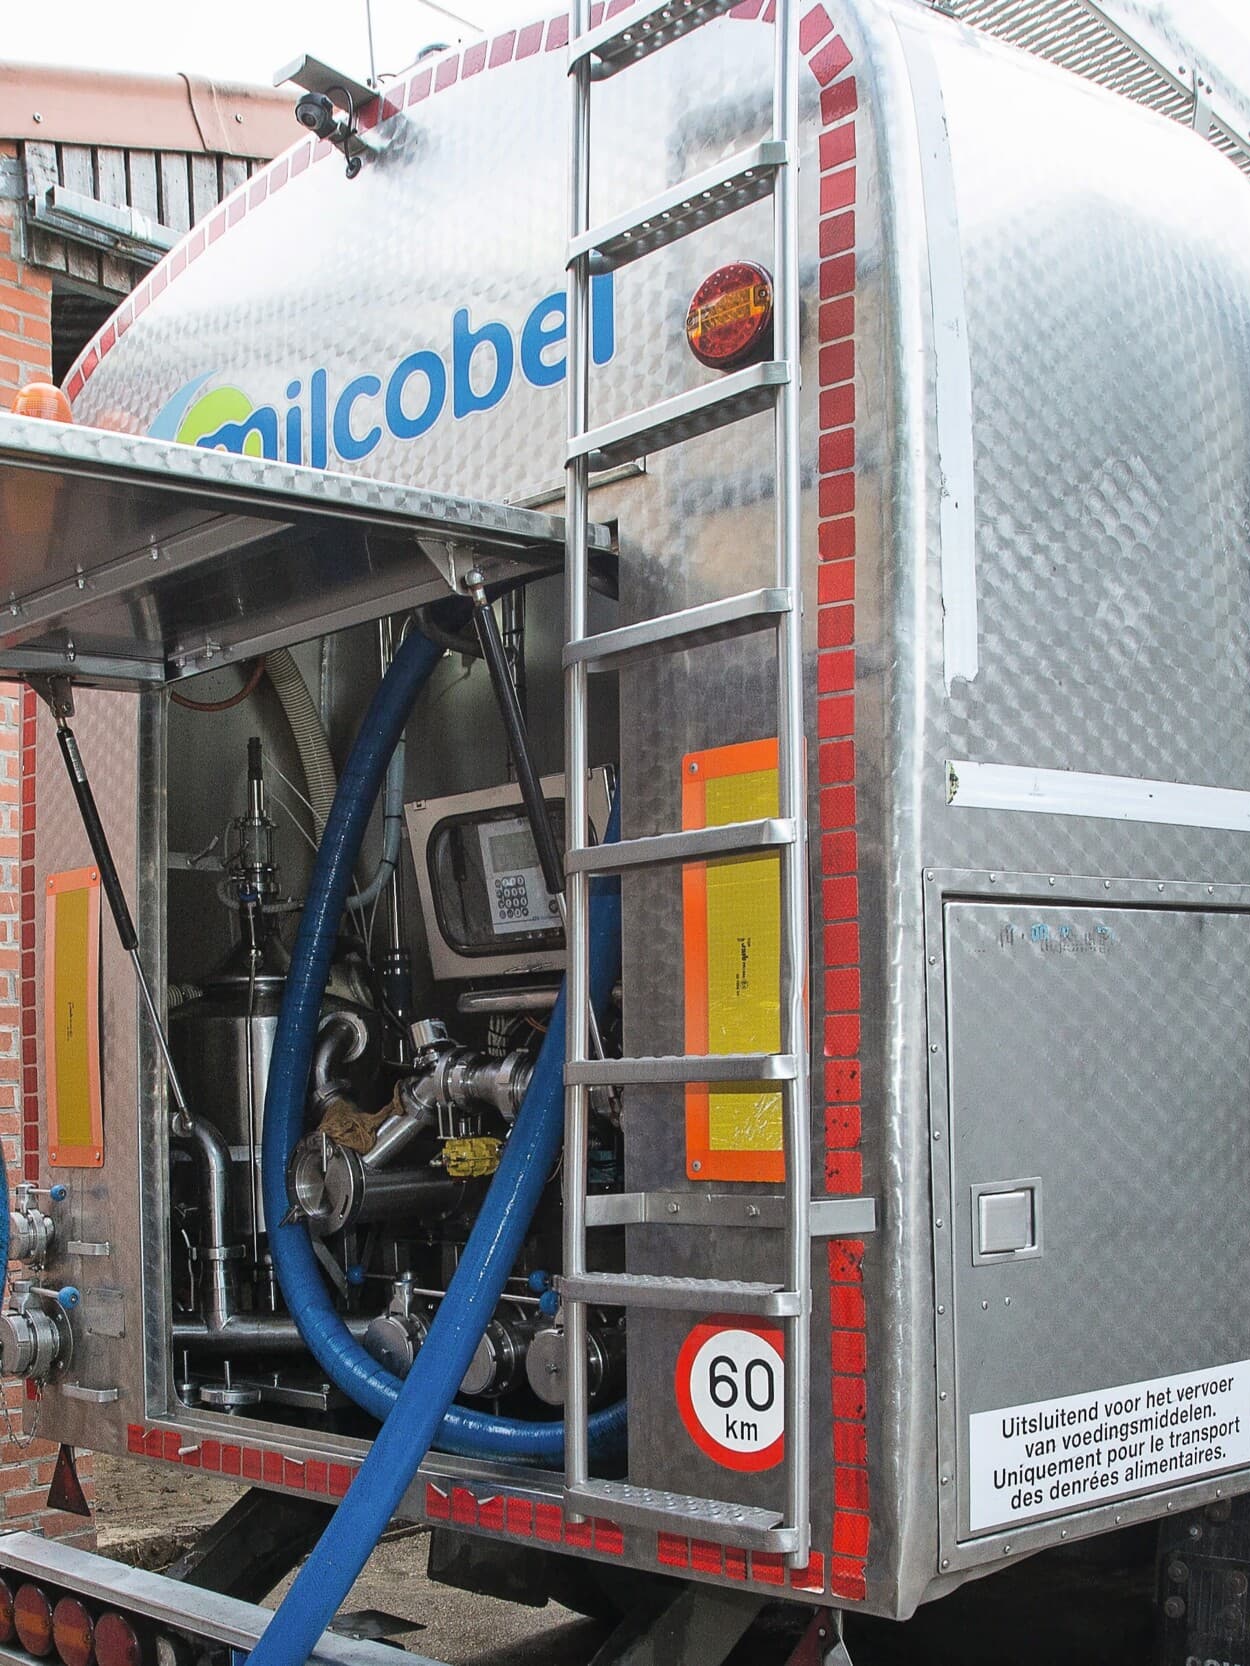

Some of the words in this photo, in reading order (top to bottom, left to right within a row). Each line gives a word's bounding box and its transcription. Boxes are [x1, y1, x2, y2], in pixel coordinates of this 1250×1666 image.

[709, 1355, 775, 1412] 60
[1002, 1401, 1098, 1439] Uitsluitend
[1104, 1396, 1141, 1417] voor
[1146, 1387, 1172, 1409] het
[1176, 1377, 1234, 1402] vervoer
[725, 1413, 758, 1442] km
[993, 1448, 1102, 1489] Uniquement
[1107, 1441, 1145, 1467] pour
[1150, 1435, 1164, 1453] le
[1169, 1416, 1240, 1448] transport
[1025, 1438, 1056, 1458] van
[1062, 1404, 1217, 1450] voedingsmiddelen.
[1011, 1489, 1043, 1510] des
[1049, 1470, 1119, 1501] denrées
[1124, 1446, 1226, 1482] alimentaires.
